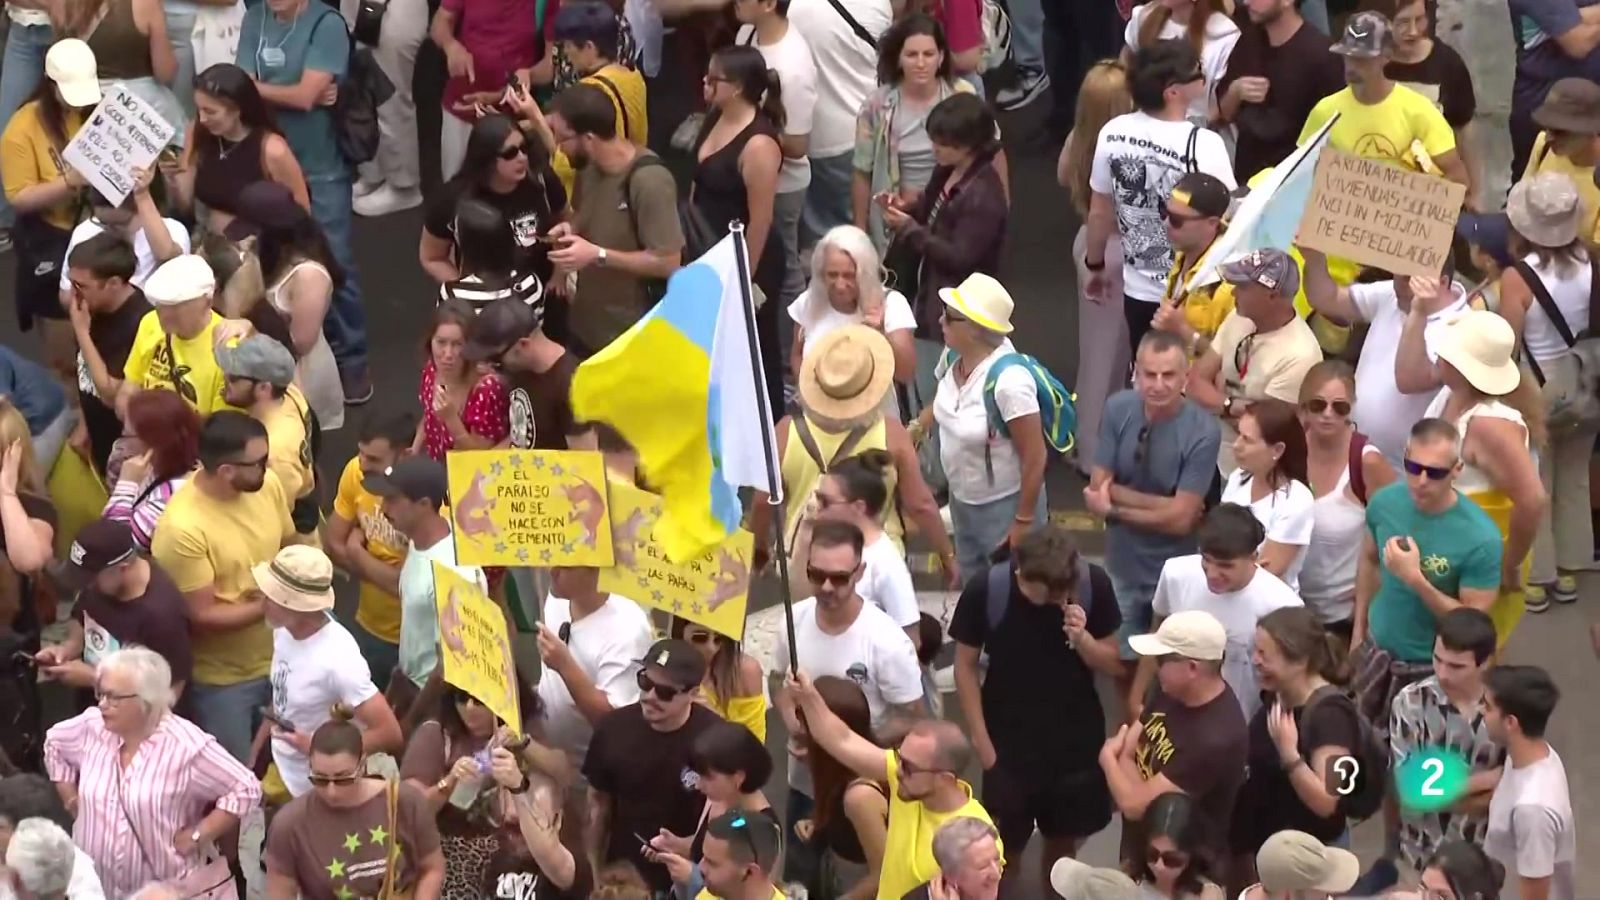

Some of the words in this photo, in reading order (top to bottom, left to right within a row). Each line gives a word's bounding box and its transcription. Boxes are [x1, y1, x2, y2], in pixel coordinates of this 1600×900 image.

[1317, 216, 1336, 237] DE
[513, 470, 530, 480] EL
[511, 502, 526, 513] NO
[529, 501, 545, 514] SE
[509, 518, 538, 529] HACE
[541, 517, 564, 529] CON
[508, 533, 565, 545] CEMENTO
